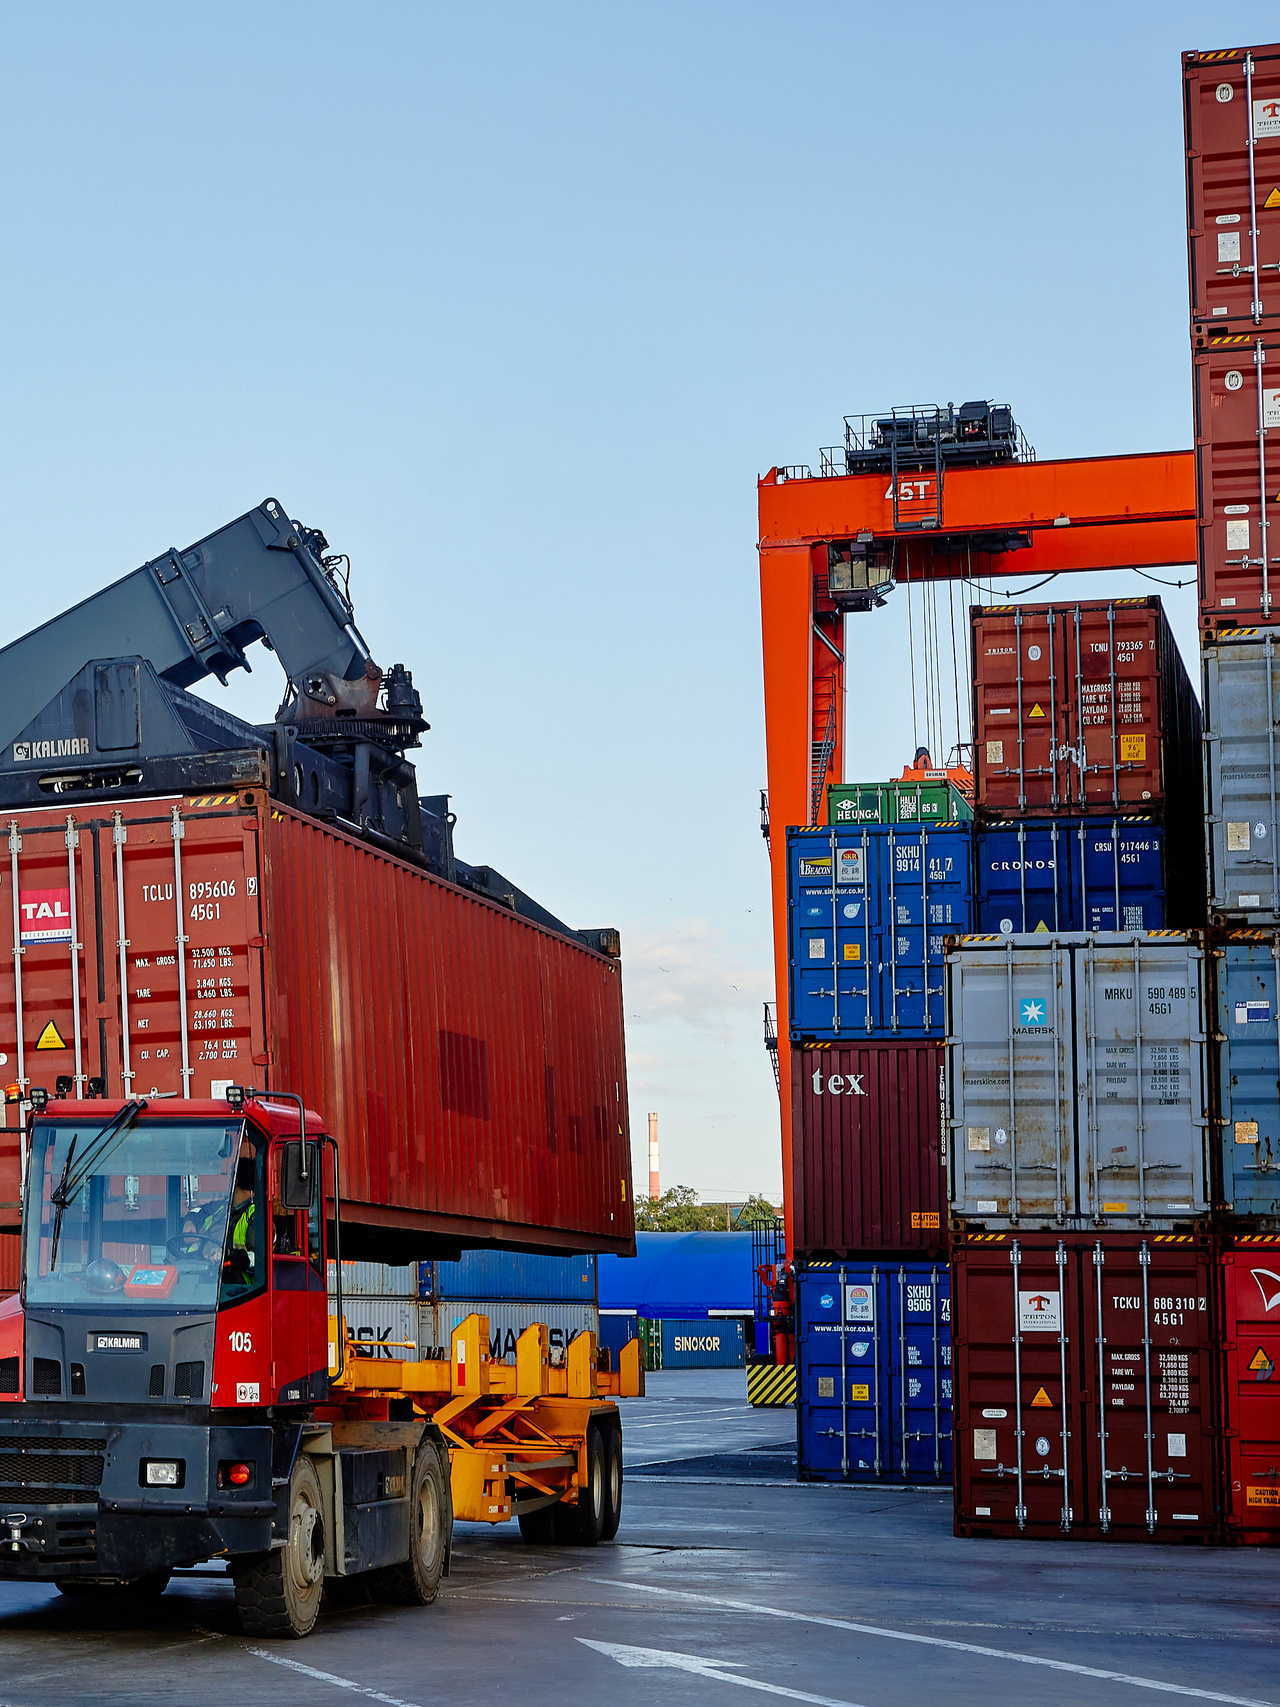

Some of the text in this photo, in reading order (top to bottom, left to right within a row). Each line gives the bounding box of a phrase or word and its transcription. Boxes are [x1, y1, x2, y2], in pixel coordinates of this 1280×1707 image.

[884, 481, 930, 500] 45T
[1090, 640, 1155, 653] TCNU 793365 7
[1117, 653, 1134, 662] 45G1
[1082, 694, 1109, 704] TARE WT.
[1082, 705, 1108, 714] PAYLOAD
[32, 738, 89, 759] KALMAR
[900, 803, 938, 813] 2056 65 3
[896, 846, 920, 858] SKHU
[1094, 841, 1159, 852] CRSU 917446 3
[1121, 853, 1140, 863] 45G1
[804, 864, 831, 874] BEACON
[896, 858, 953, 871] 9914 41 7
[991, 860, 1055, 871] CRONOS
[929, 871, 946, 880] 45G1
[142, 877, 257, 902] TCLU 895606 9
[806, 887, 864, 895] www.sinkor.co.kr
[21, 901, 69, 919] TAL
[190, 903, 220, 921] 45G1
[191, 947, 233, 958] 32.500 KGS.
[135, 956, 234, 969] MAX. GROSS 71.650 LBS.
[196, 978, 233, 988] 3.840 KGS.
[136, 988, 235, 999] TARE 8.460 LBS.
[1105, 987, 1196, 1000] MRKU 590 489 5
[193, 1009, 234, 1019] 28.660 KGS.
[1149, 1003, 1171, 1015] 45G1
[138, 1019, 234, 1029] NET 63.190 LBS.
[1013, 1027, 1054, 1035] MAERSK
[204, 1040, 218, 1050] 76.4
[141, 1050, 150, 1060] CU.
[156, 1049, 170, 1058] CAP.
[199, 1051, 217, 1060] 2.700
[964, 1078, 1010, 1086] maerskline.com
[907, 1286, 931, 1298] SKHU
[907, 1299, 931, 1312] 9506
[1113, 1297, 1206, 1311] TCKU 686 310 2
[1154, 1313, 1184, 1326] 45G1
[107, 1338, 140, 1348] KALMAR
[228, 1331, 252, 1352] 105
[674, 1336, 720, 1351] SINOKOR
[1112, 1383, 1135, 1391] PAYLOAD
